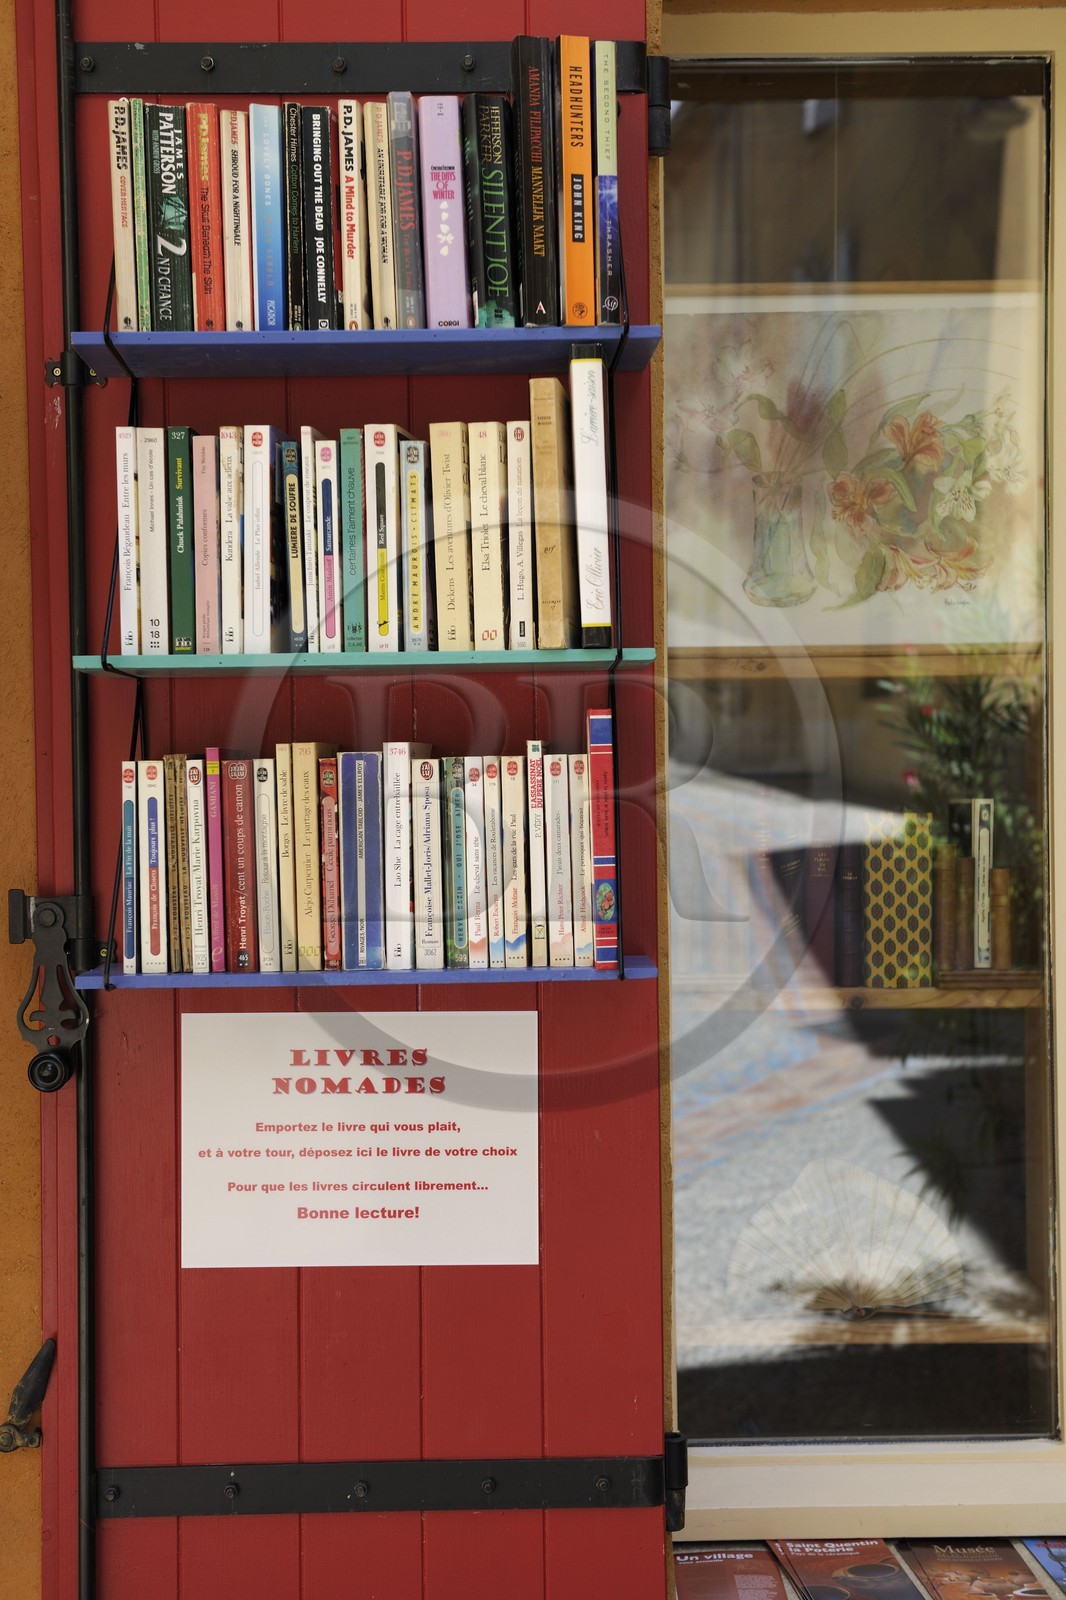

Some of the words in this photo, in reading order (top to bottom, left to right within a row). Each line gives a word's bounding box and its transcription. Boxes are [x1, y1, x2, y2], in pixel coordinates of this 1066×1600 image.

[528, 66, 540, 106] AMANDA
[569, 66, 583, 148] HEADHUNTERS
[289, 108, 297, 135] Chester
[312, 114, 321, 161] BRINGING
[479, 105, 492, 164] PARKER
[491, 105, 502, 164] JEFFERSON
[530, 110, 542, 162] FILIPACCHI
[159, 112, 176, 194] PATTERSON
[175, 129, 184, 179] JAMES
[290, 137, 298, 162] Himes
[343, 132, 353, 171] JAMES
[231, 149, 239, 178] SHROUD
[313, 164, 322, 183] OUT
[232, 180, 240, 193] FOR
[431, 172, 441, 181] THE
[442, 172, 456, 181] DAYS
[436, 182, 448, 190] OF
[314, 185, 322, 203] THE
[345, 186, 354, 209] Mind
[433, 190, 455, 200] WINTER
[531, 166, 544, 221] MANNELIJK
[573, 178, 583, 205] JOHN
[201, 204, 209, 222] Skull
[315, 206, 323, 230] DEAD
[346, 212, 353, 222] to
[482, 168, 507, 252] SILENT
[233, 201, 241, 246] NIGHTINGALE
[574, 212, 584, 239] KING
[202, 225, 211, 258] Beneath
[314, 237, 324, 253] JOE
[346, 224, 355, 259] Murder
[533, 225, 545, 257] NAAKT
[203, 260, 211, 274] The
[316, 255, 326, 303] CONNELLY
[486, 256, 509, 297] JOE
[204, 277, 212, 294] Skin
[267, 300, 275, 325] PICADOR
[172, 431, 185, 439] 327
[225, 456, 233, 479] adieux
[442, 454, 451, 475] Twist
[347, 468, 355, 501] chauve
[443, 477, 452, 512] d'Olivier
[176, 496, 184, 529] Palahniuk
[225, 513, 232, 523] La
[290, 514, 296, 522] DE
[347, 503, 355, 533] l'aiment
[445, 514, 454, 553] aventures
[348, 535, 356, 575] certaines
[446, 555, 454, 570] Les
[585, 547, 604, 589] Ollivier
[447, 578, 455, 610] Dickens
[150, 619, 159, 627] 10
[235, 784, 243, 812] canon
[280, 788, 287, 797] de
[235, 815, 243, 825] de
[281, 816, 288, 826] Le
[394, 820, 402, 838] cage
[236, 828, 245, 854] coups
[282, 833, 290, 858] Borges
[393, 839, 401, 849] La
[236, 857, 244, 868] un
[239, 927, 247, 948] Henri
[290, 1048, 428, 1067] LIVRES
[272, 1076, 447, 1095] NOMADES
[255, 1122, 318, 1134] Emportez
[321, 1122, 333, 1131] le
[337, 1122, 366, 1131] livre
[370, 1122, 390, 1134] qui
[393, 1123, 424, 1131] vous
[427, 1121, 461, 1133] plait,
[198, 1148, 212, 1157] et
[215, 1147, 224, 1157] à
[228, 1148, 262, 1157] votre
[265, 1148, 295, 1159] tour,
[299, 1147, 353, 1159] déposez
[356, 1147, 372, 1156] ici
[376, 1147, 389, 1156] le
[392, 1147, 421, 1156] livre
[424, 1147, 441, 1156] de
[445, 1147, 478, 1156] votre
[482, 1147, 518, 1156] choix
[227, 1182, 258, 1191] Pour
[261, 1183, 285, 1193] que
[289, 1181, 308, 1191] les
[312, 1181, 348, 1191] livres
[352, 1181, 411, 1190] circulent
[414, 1181, 489, 1190] librement...
[297, 1207, 350, 1219] Bonne
[355, 1206, 420, 1219] lecture!
[824, 1540, 879, 1548] Quentin
[933, 1544, 995, 1554] Musée
